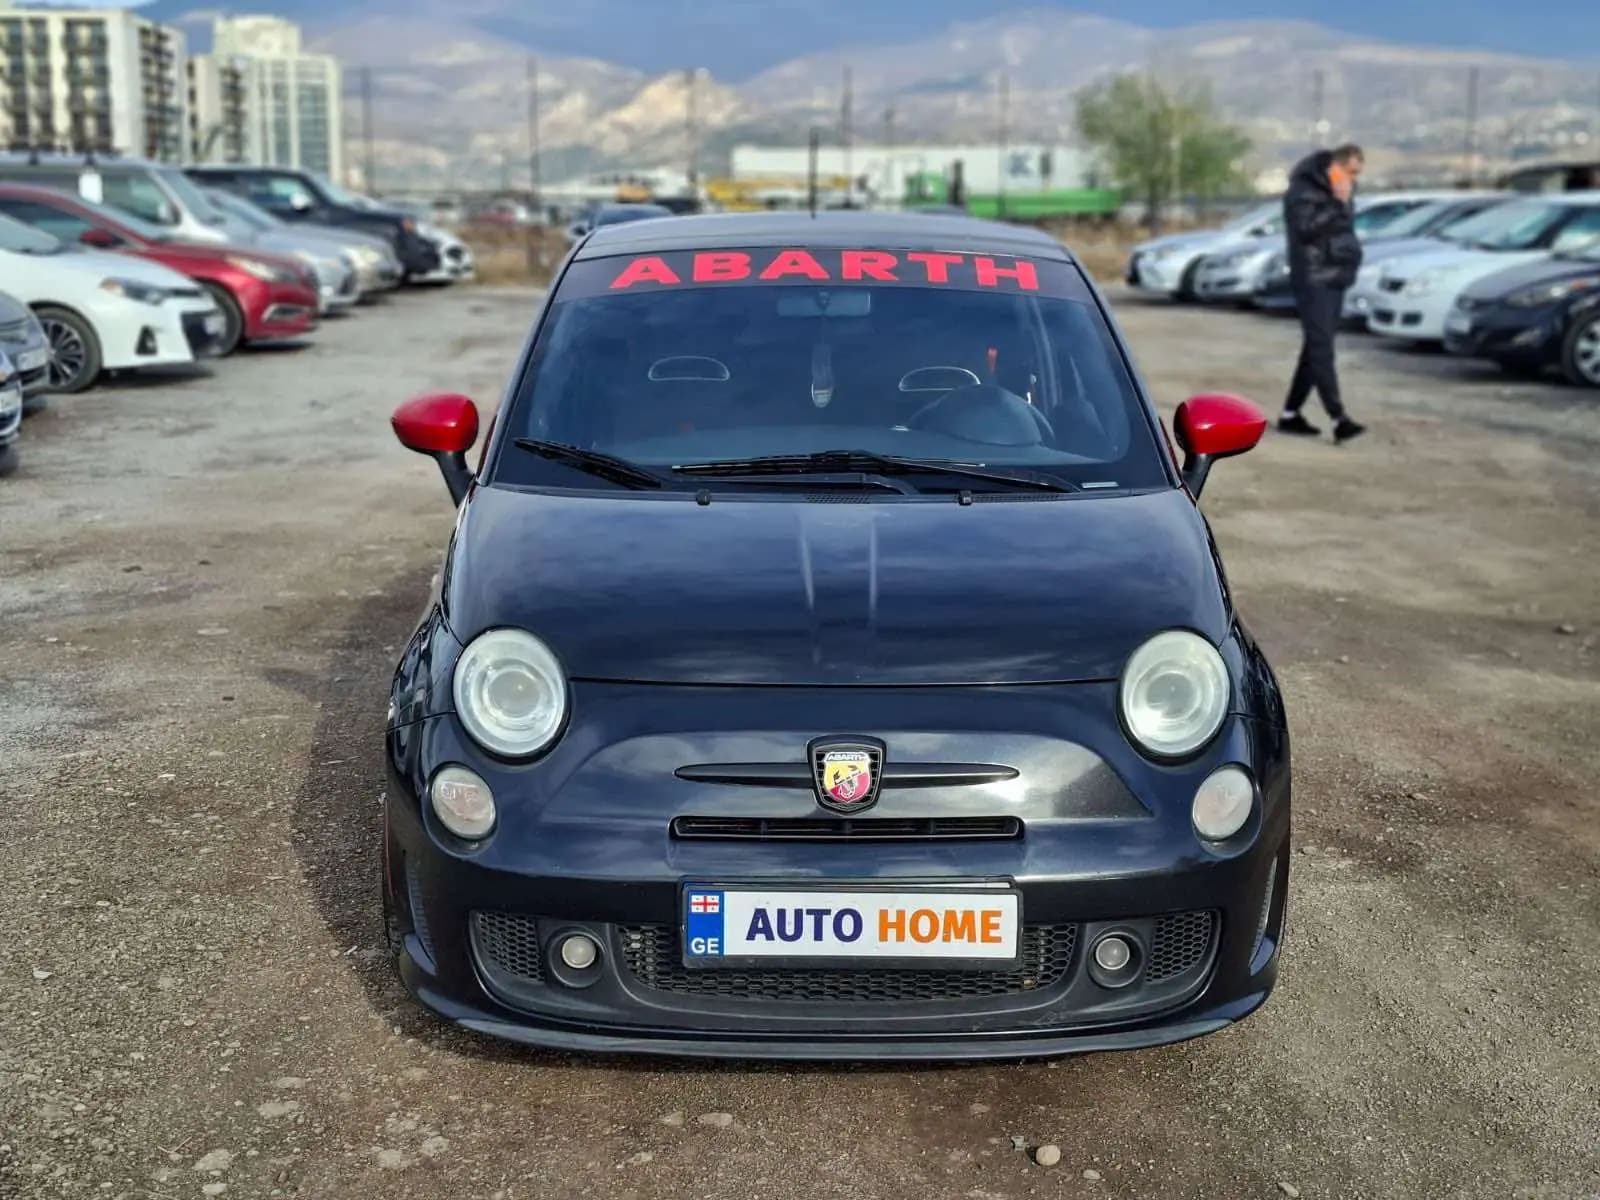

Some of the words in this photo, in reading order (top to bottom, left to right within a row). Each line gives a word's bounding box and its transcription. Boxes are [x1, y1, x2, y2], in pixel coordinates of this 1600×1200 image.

[608, 250, 1040, 290] ABARTH
[745, 908, 863, 942] AUTO
[878, 909, 1003, 943] HOME
[691, 938, 719, 954] GE
